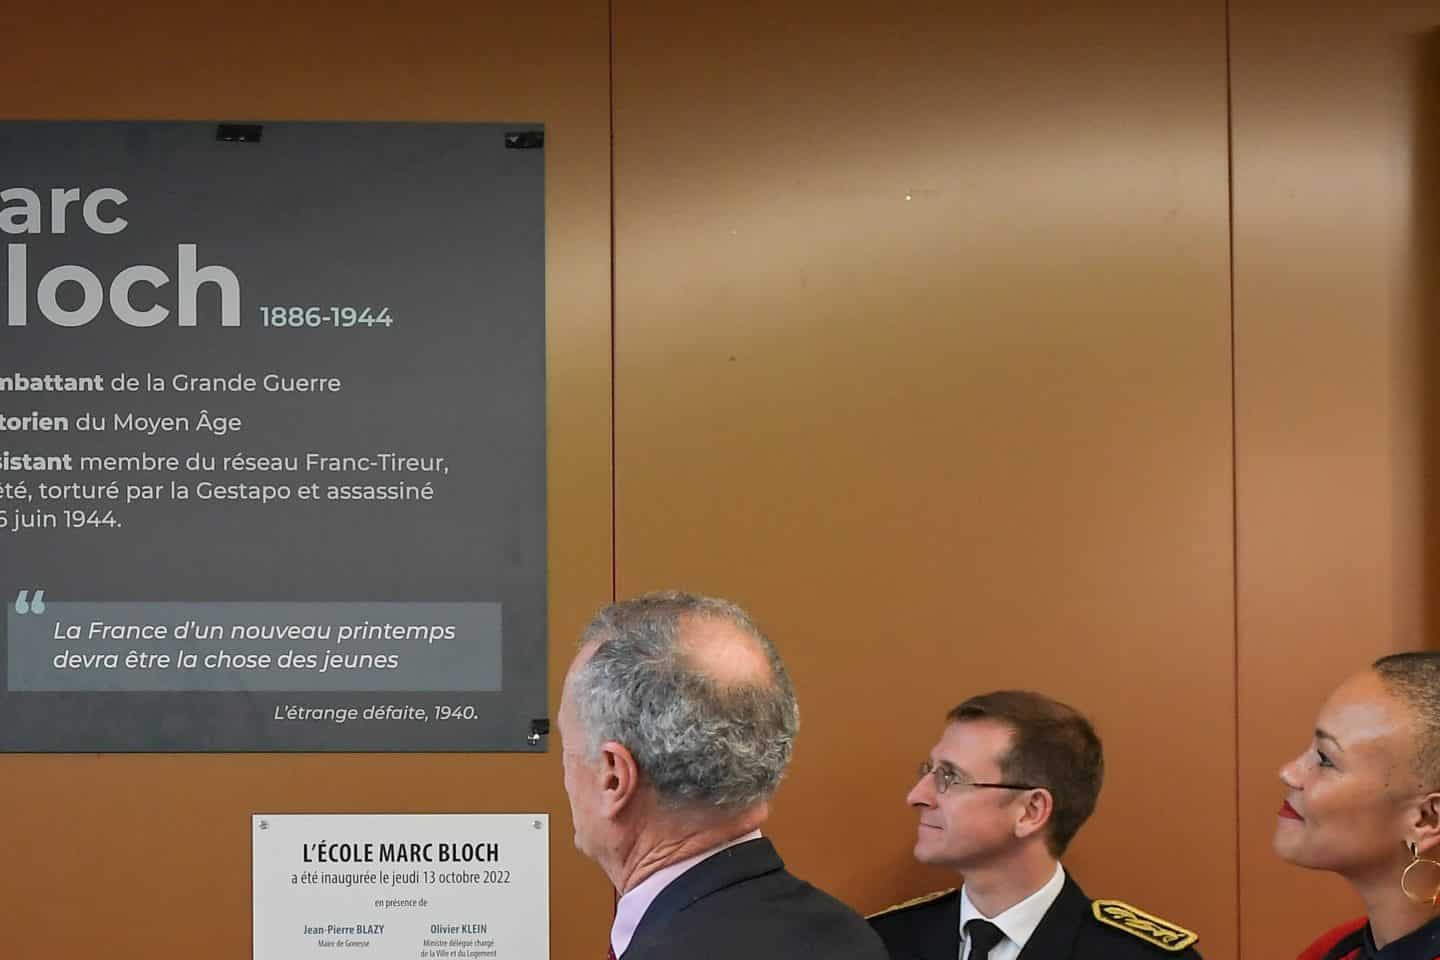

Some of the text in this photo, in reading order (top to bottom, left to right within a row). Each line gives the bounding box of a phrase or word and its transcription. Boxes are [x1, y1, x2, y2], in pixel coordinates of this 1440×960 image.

[259, 306, 394, 327] 1886-1944
[111, 372, 140, 392] de
[147, 372, 165, 392] la
[172, 373, 257, 392] Grande
[263, 374, 342, 393] Guerre
[75, 412, 106, 431] du
[114, 412, 189, 436] Moyen
[195, 409, 242, 436] Âge
[80, 451, 180, 471] membre
[185, 451, 215, 471] du
[223, 452, 298, 471] réseau
[306, 452, 449, 475] Franc-Tireur,
[38, 480, 120, 500] torturé
[126, 485, 164, 504] par
[171, 480, 189, 500] la
[196, 481, 291, 504] Gestapo
[297, 482, 321, 500] et
[326, 481, 434, 500] assassiné
[11, 508, 57, 532] juin
[63, 509, 122, 529] 1944.
[53, 620, 456, 644] La France d'un nouveau printemps
[53, 649, 399, 674] devra être la chose des jeunes
[274, 704, 479, 724] L'étrange défaite, 1940.
[303, 839, 499, 863] L'ÉCOLE MARC BLOCH
[291, 869, 511, 888] a été inaugurée le jeudi 13 octobre 2022
[374, 897, 428, 910] en présence de
[303, 924, 385, 935] Jean-Pierre BLAZY
[430, 923, 487, 935] Olivier KLEIN
